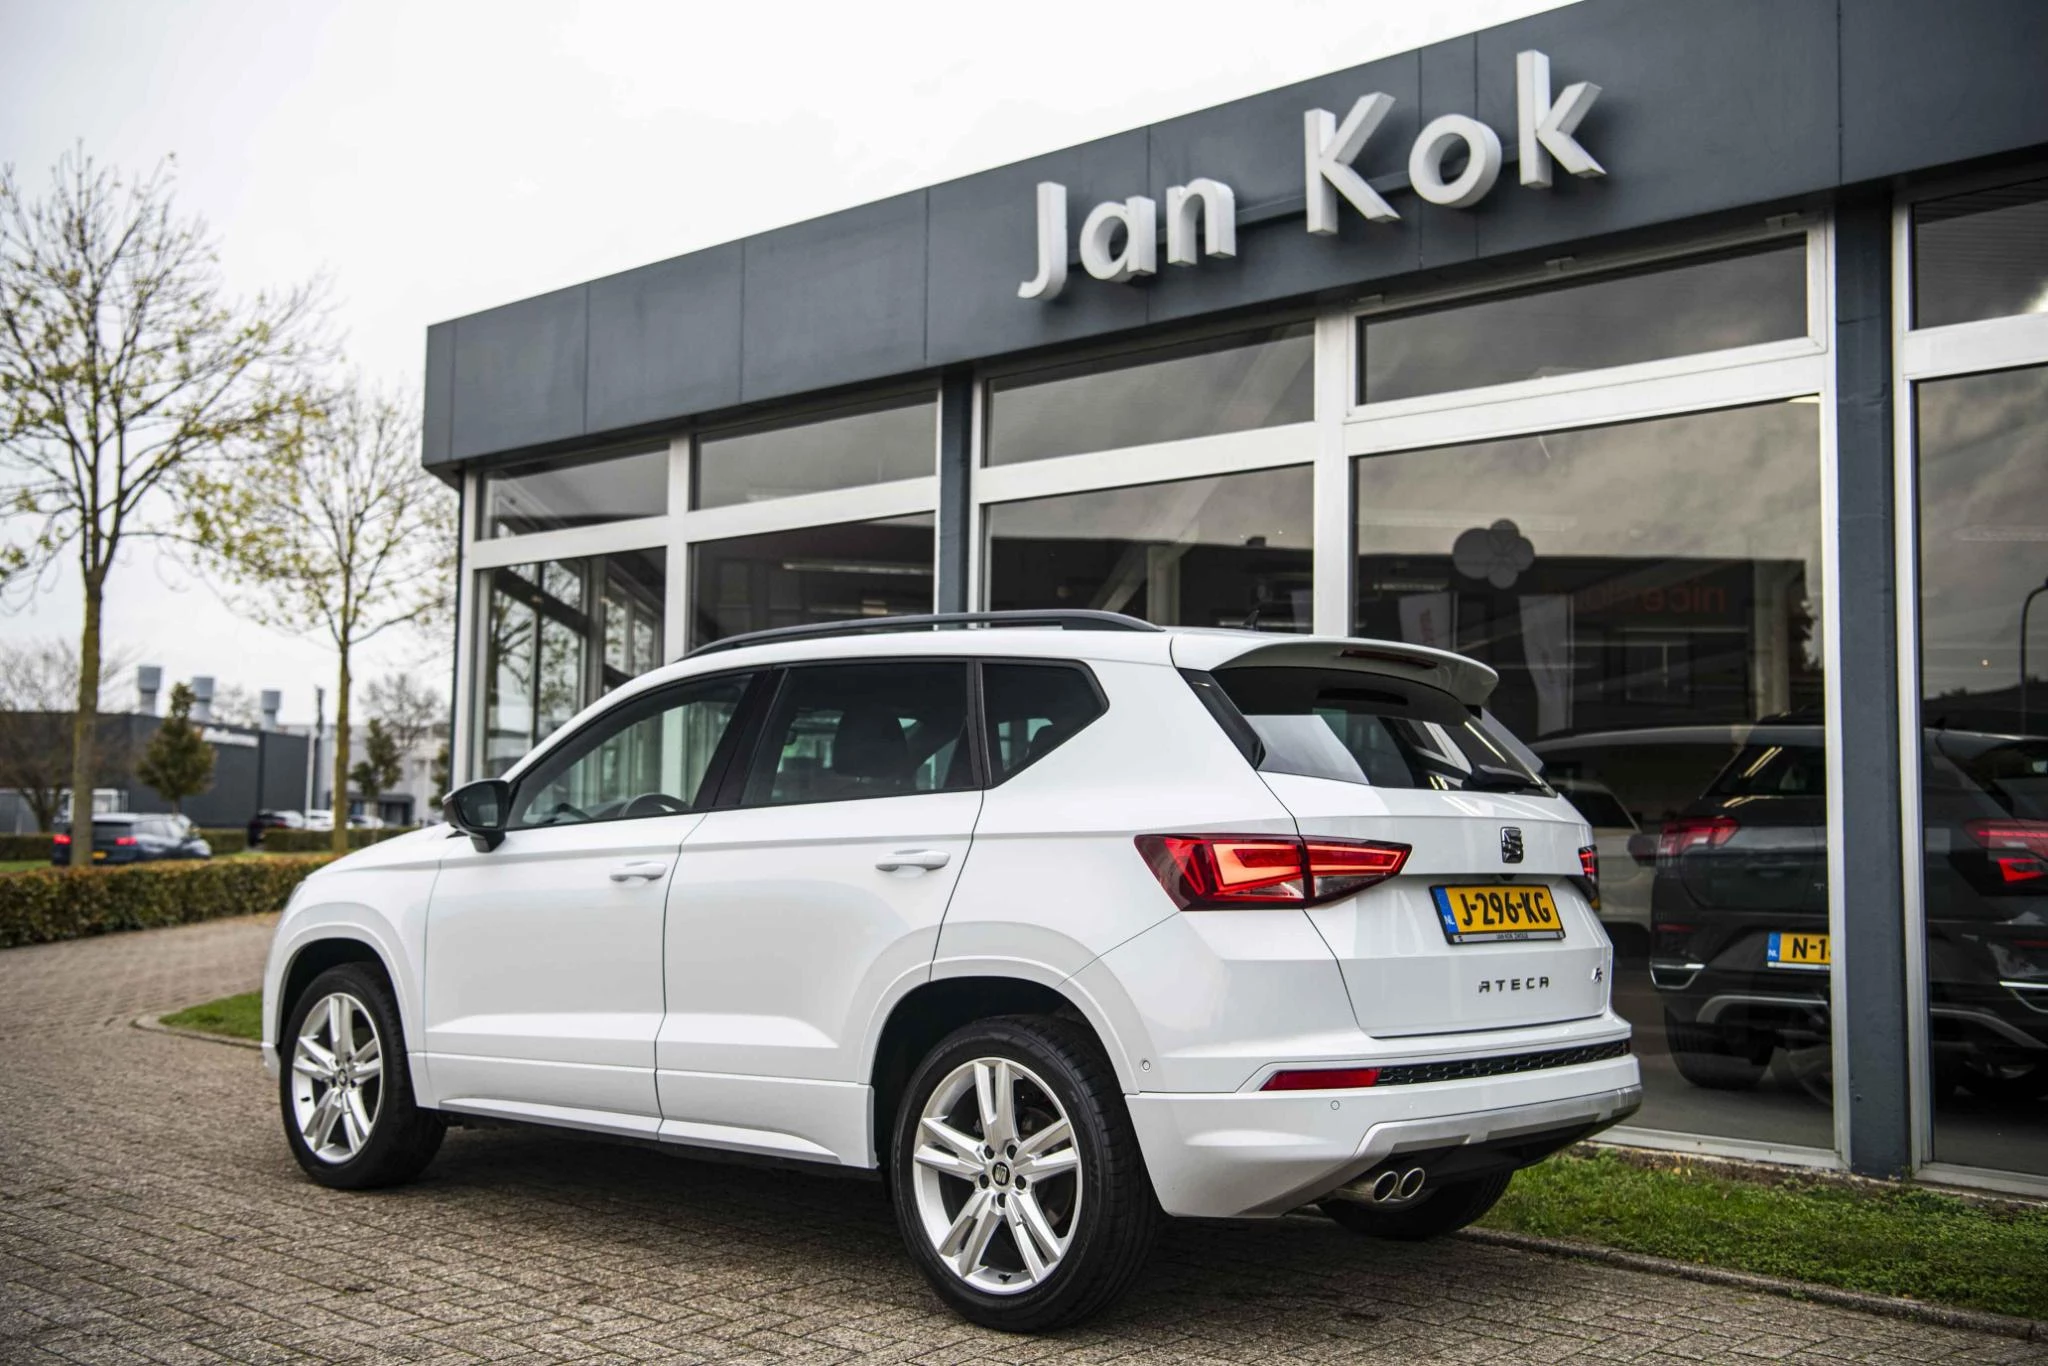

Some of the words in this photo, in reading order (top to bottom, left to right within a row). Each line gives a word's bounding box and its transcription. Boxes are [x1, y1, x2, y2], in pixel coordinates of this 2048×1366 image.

[1018, 177, 1237, 299] Jan
[1304, 48, 1607, 236] Kok
[1460, 892, 1551, 926] J-296-KG
[1767, 949, 1778, 958] NL
[1792, 937, 1831, 960] N-1
[1479, 976, 1549, 993] ATECA
